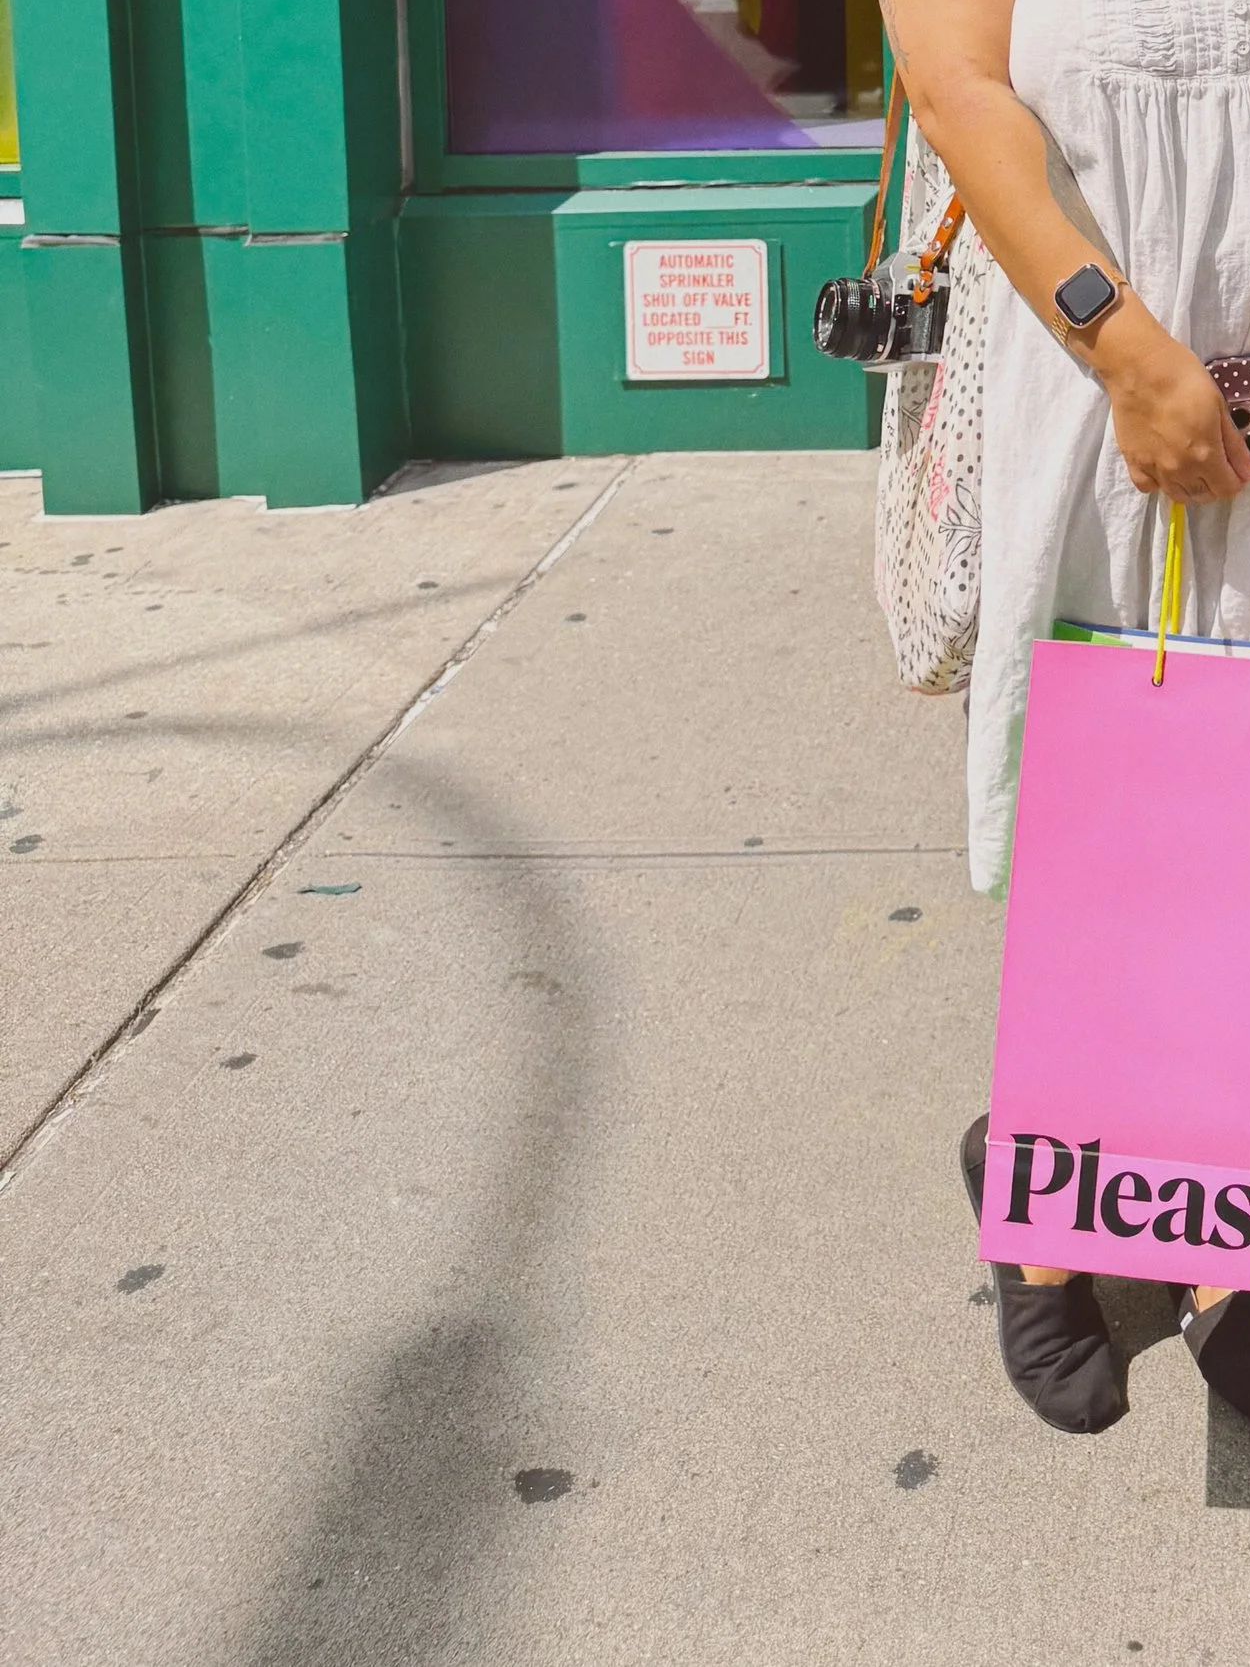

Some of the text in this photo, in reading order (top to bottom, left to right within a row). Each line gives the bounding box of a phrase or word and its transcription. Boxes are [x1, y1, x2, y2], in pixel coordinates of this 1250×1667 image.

[658, 253, 735, 270] AUTOMATIC
[659, 272, 735, 289] SPRINKLER
[642, 291, 753, 309] SHUT OFF VALVE
[641, 311, 702, 328] LOCATED
[647, 330, 749, 347] OPPOSITE THIS
[682, 349, 716, 366] SIGN
